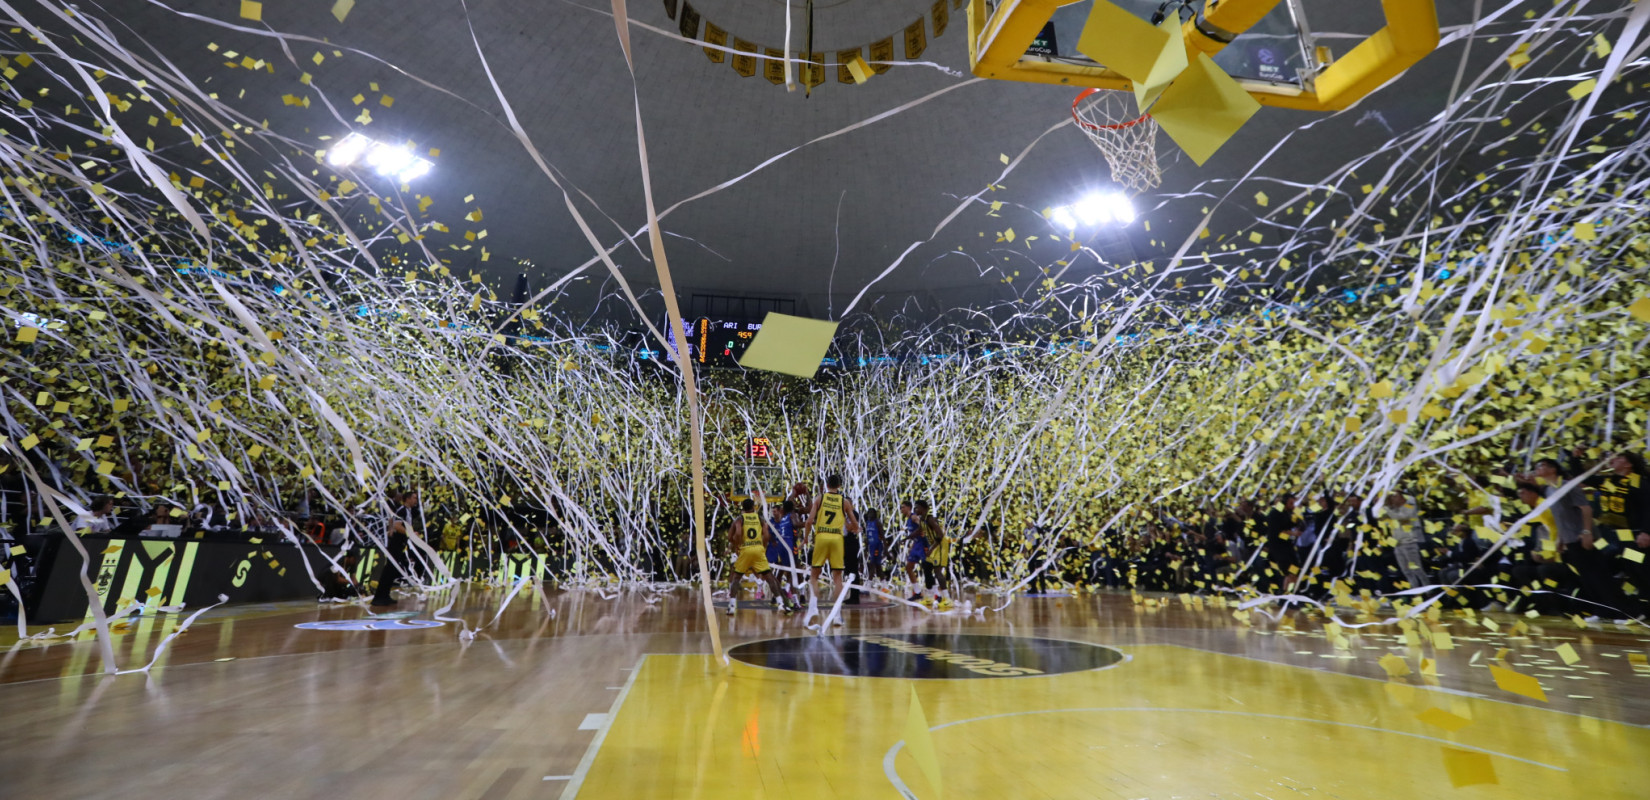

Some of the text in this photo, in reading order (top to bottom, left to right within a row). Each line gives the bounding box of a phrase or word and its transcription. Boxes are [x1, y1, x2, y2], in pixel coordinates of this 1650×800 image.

[751, 445, 766, 456] 23
[825, 510, 836, 524] 7
[747, 528, 757, 539] 0
